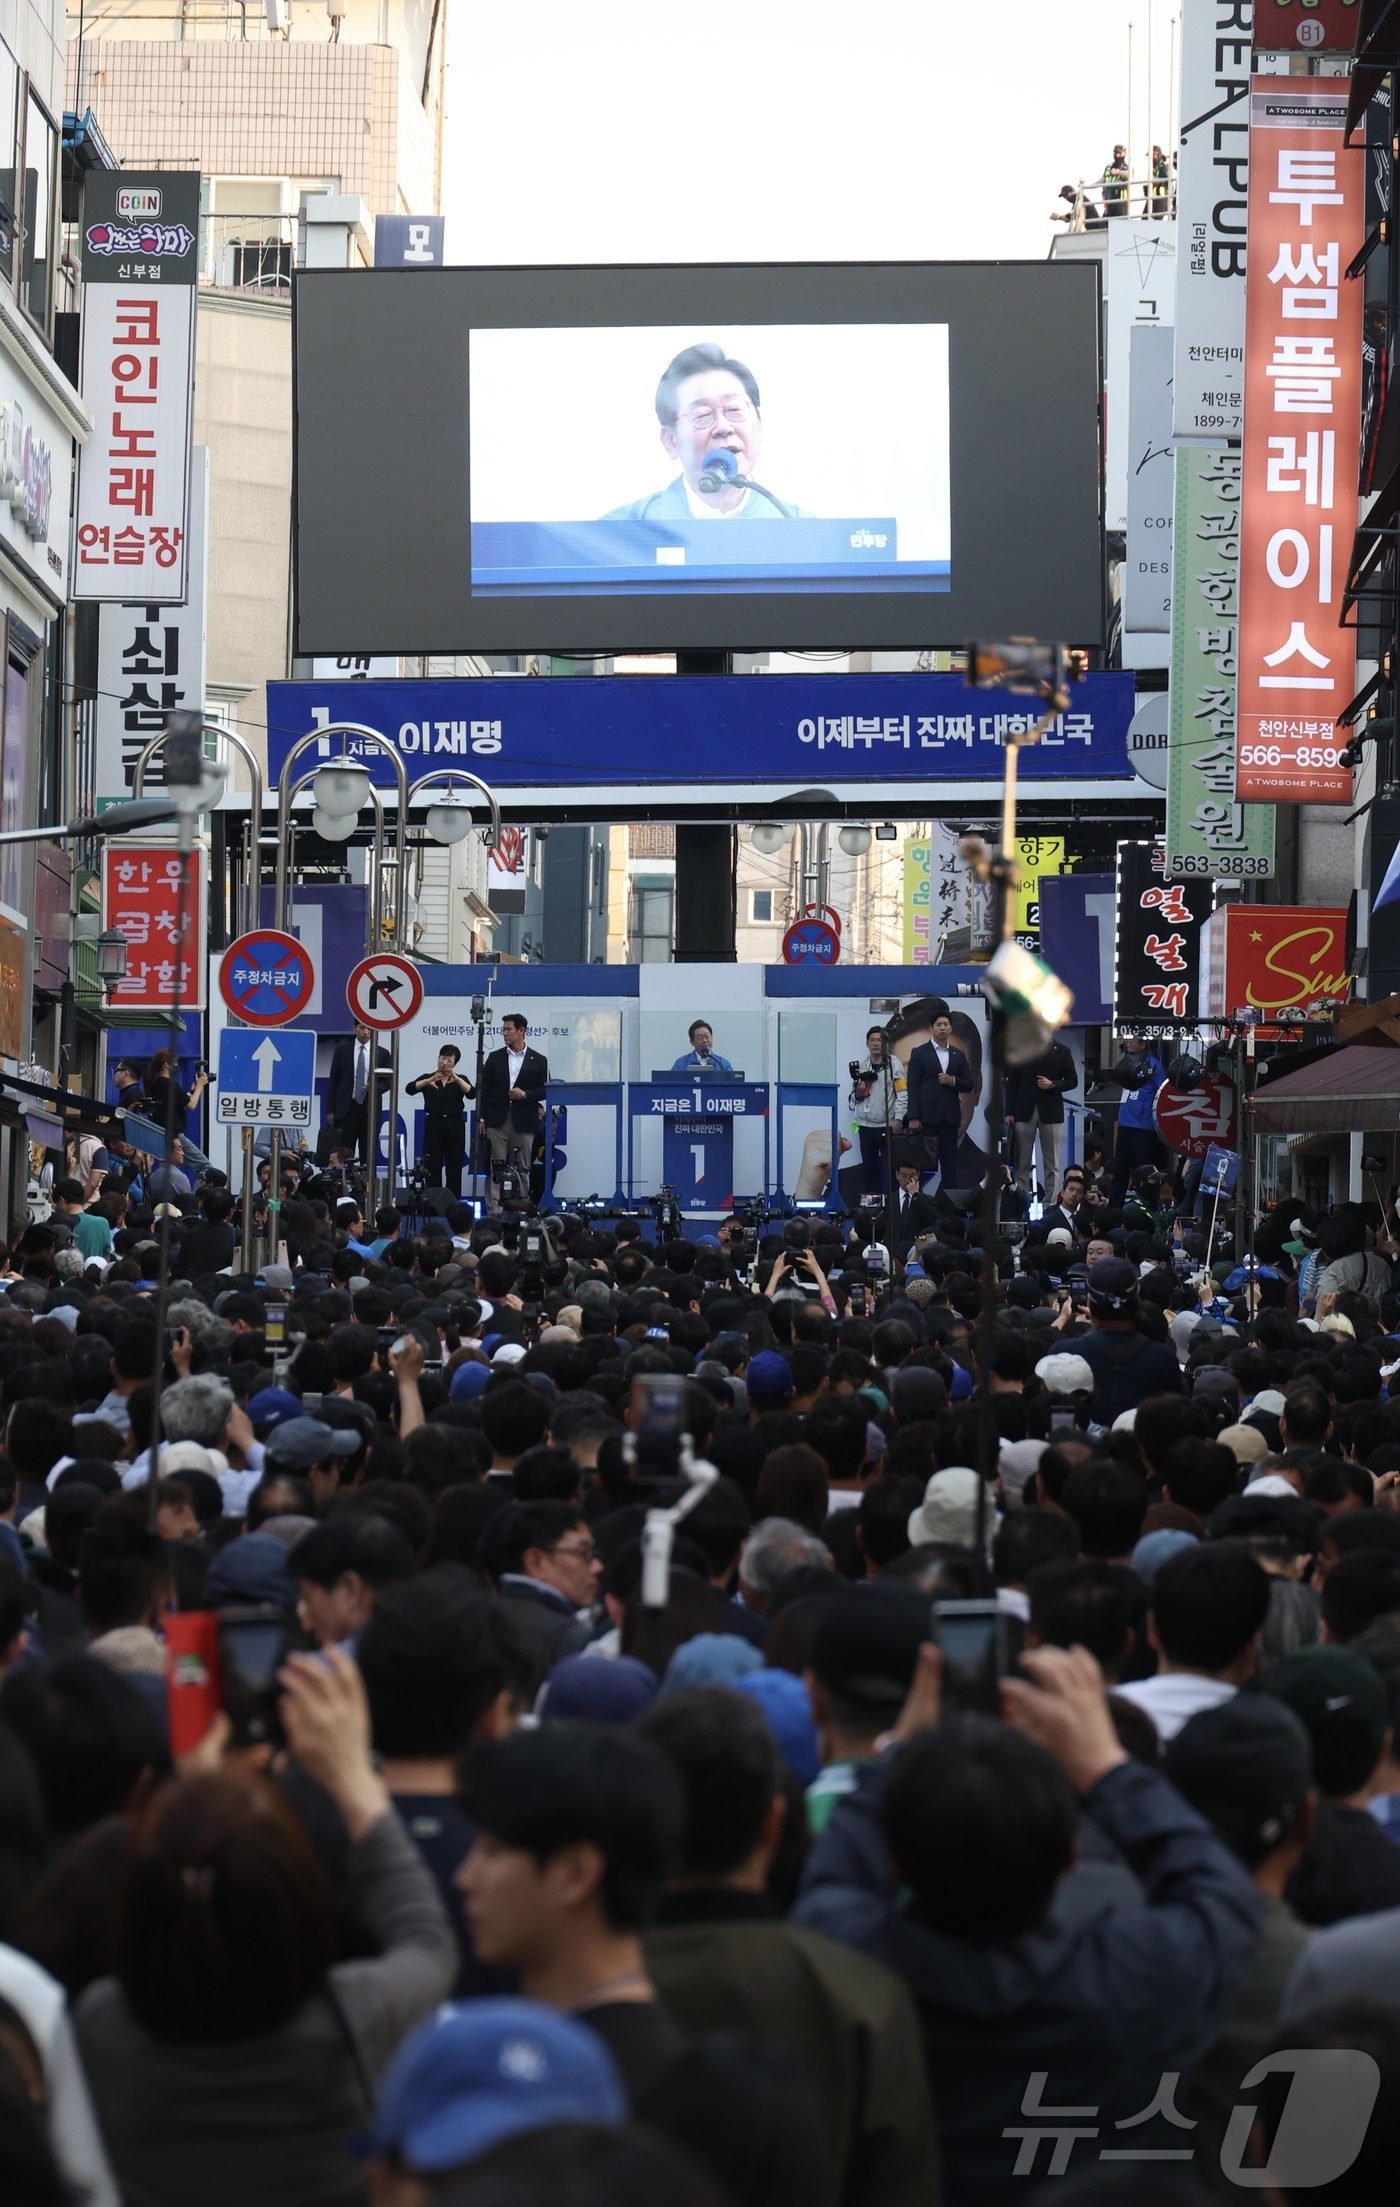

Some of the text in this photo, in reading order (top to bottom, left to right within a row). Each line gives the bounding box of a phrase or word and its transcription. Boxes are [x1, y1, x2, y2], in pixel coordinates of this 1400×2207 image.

[1300, 24, 1320, 41] B1
[120, 195, 158, 210] COIN
[117, 264, 162, 279] 신부점
[111, 299, 161, 517] 코인노래
[1193, 414, 1242, 428] 1899-7
[1258, 149, 1345, 690] 투썸플레이스
[77, 524, 184, 568] 연습장
[310, 706, 331, 757] 1
[399, 720, 503, 755] 이재명
[797, 713, 1095, 749] 이제부터 진짜 대한민국
[1258, 720, 1334, 740] 천안신부점
[1254, 777, 1307, 787] TWOSOME
[1309, 779, 1343, 788] PLACE
[113, 860, 191, 893] 한우
[1171, 855, 1270, 876] 563-3838
[115, 910, 192, 944] 곱창
[790, 942, 832, 954] 주정차금지
[233, 969, 300, 987] 주정차금지
[422, 1026, 474, 1036] 더불어민주당
[551, 1027, 569, 1037] 후보
[220, 1097, 309, 1120] 일방통행
[651, 1088, 746, 1113] 지금은 1 이재명
[1161, 1085, 1233, 1138] 침
[674, 1124, 724, 1134] 진짜 대한민국
[690, 1144, 705, 1184] 1
